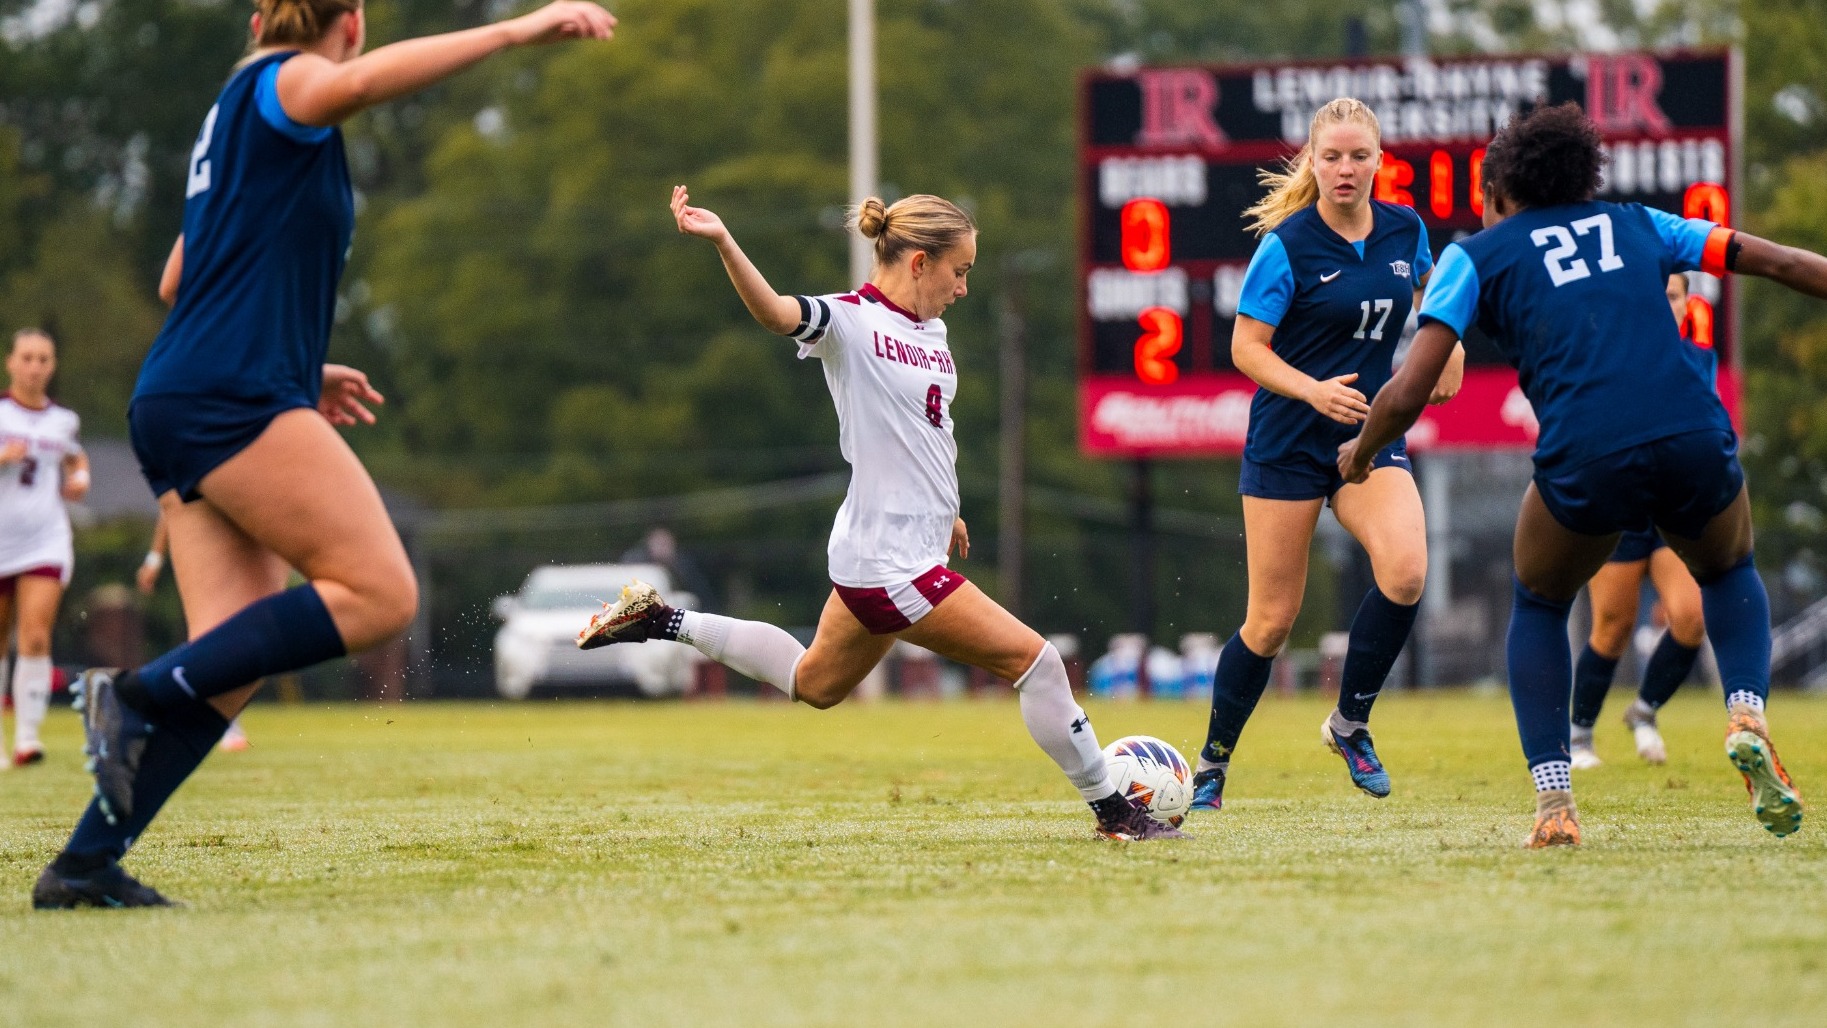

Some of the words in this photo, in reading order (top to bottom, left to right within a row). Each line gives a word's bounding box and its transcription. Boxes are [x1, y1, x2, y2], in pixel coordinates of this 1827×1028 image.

[186, 102, 219, 200] 2
[1530, 213, 1624, 287] 27
[1134, 307, 1183, 385] 2
[1353, 298, 1393, 341] 17
[873, 330, 956, 375] LENOIR-RH
[925, 383, 943, 429] 8
